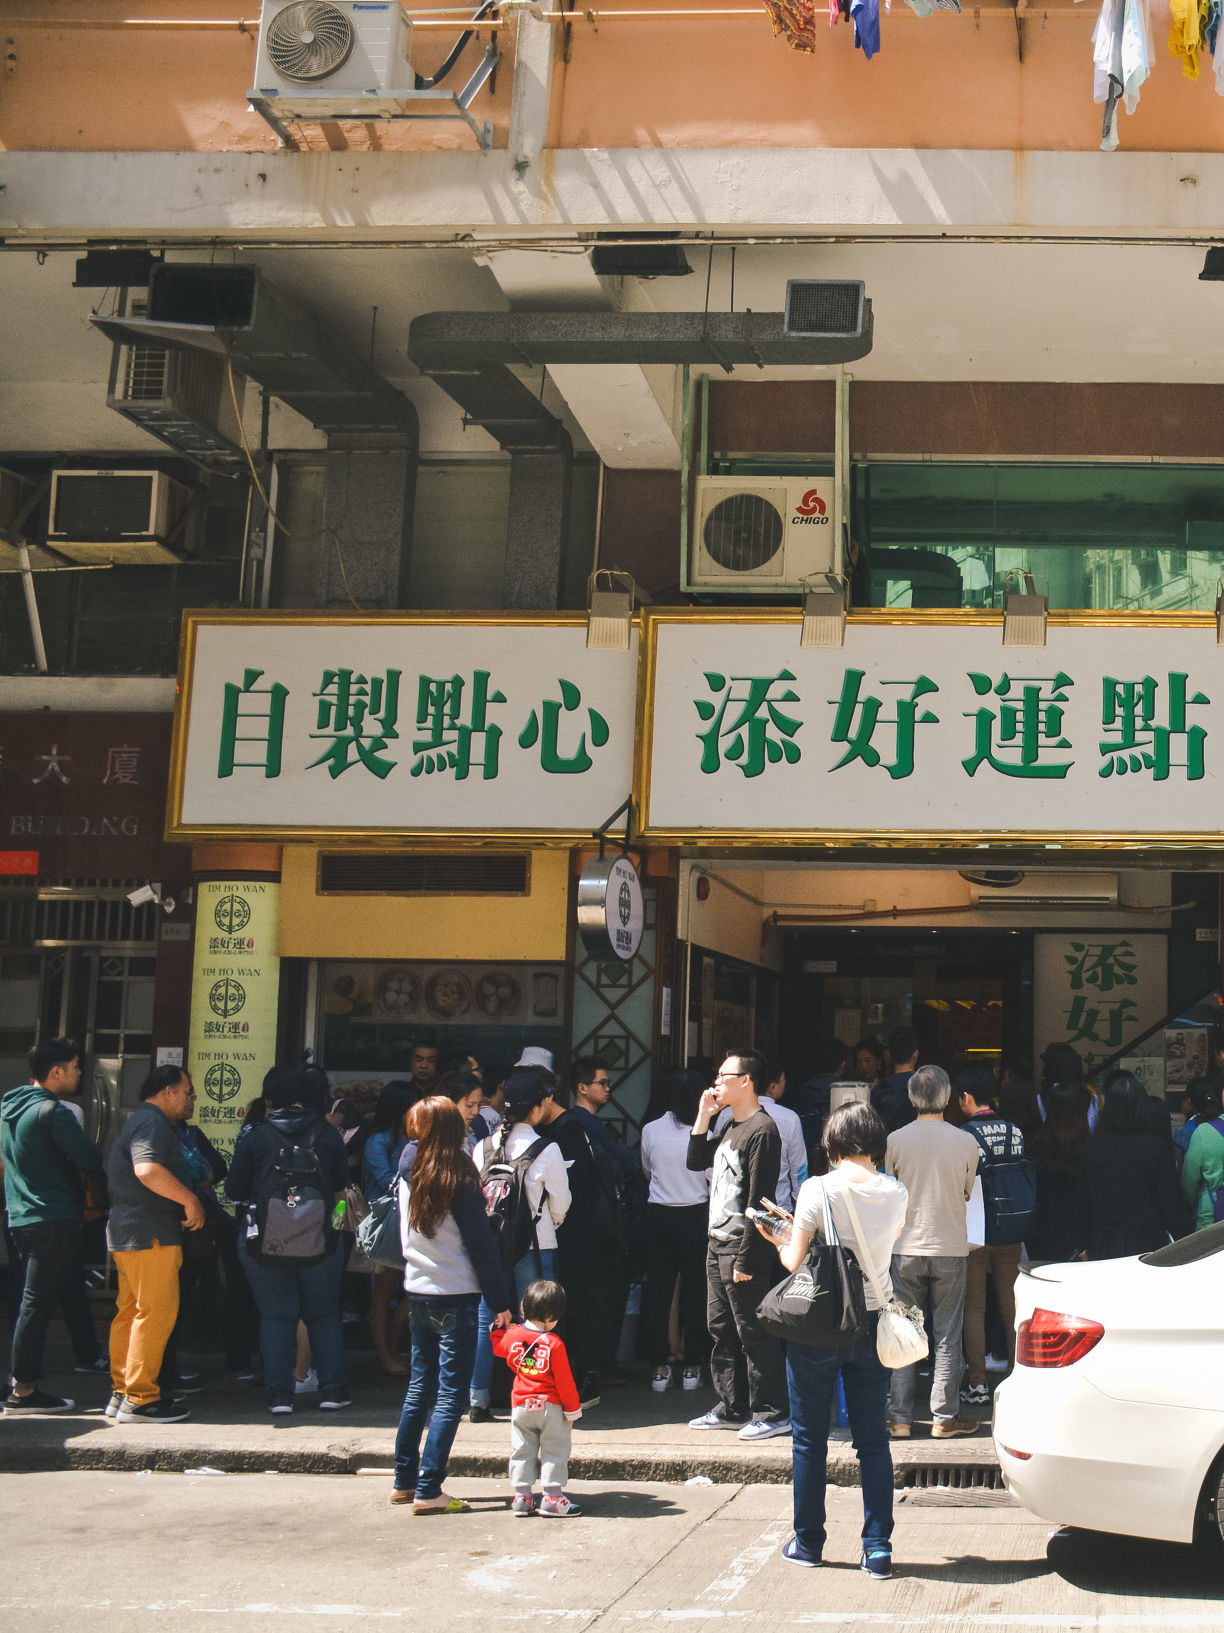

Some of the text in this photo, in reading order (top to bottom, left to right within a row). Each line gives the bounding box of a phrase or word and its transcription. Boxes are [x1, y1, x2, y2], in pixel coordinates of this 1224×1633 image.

[792, 516, 829, 525] CHIGO
[217, 667, 610, 780] 自製點心
[0, 744, 142, 785] 大廈
[208, 885, 221, 893] TIM
[242, 885, 266, 893] WAN
[209, 937, 246, 949] 添好運
[202, 968, 261, 976] TIM HO WAN
[203, 1021, 241, 1034] 添好運
[197, 1052, 211, 1060] TIM
[232, 1053, 256, 1061] WAN
[200, 1106, 236, 1119] 添好運
